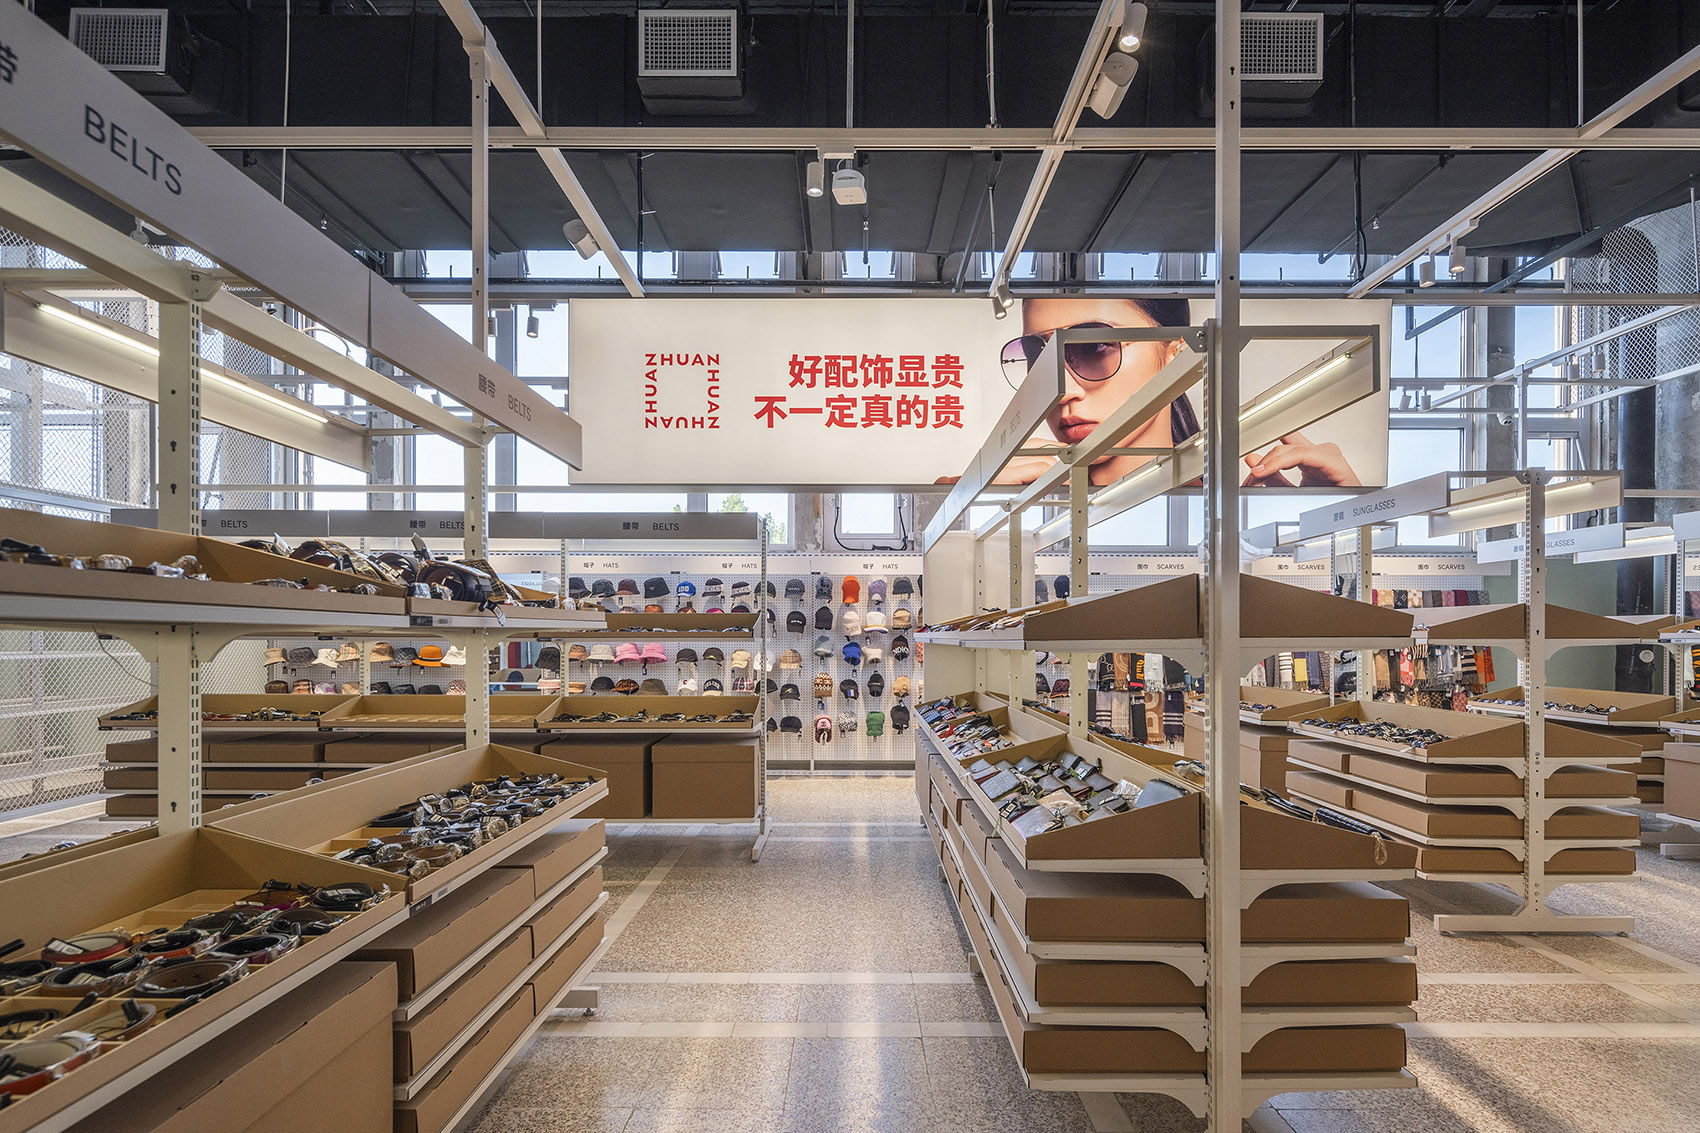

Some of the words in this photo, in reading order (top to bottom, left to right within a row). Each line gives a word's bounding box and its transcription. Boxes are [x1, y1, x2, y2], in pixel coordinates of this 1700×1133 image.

[85, 104, 182, 195] BELTS
[645, 353, 720, 366] ZHUAN
[788, 353, 965, 389] 好配饰显贵
[508, 394, 531, 421] BELTS
[754, 393, 965, 429] 不一定真的贵
[1352, 498, 1396, 517] SUNGLASSES
[220, 519, 248, 529] BELTS
[409, 520, 426, 529] 腰带
[439, 521, 465, 530] BELTS
[622, 521, 640, 531] 腰带
[652, 522, 680, 531] BELTS
[1546, 538, 1575, 549] GLASSES
